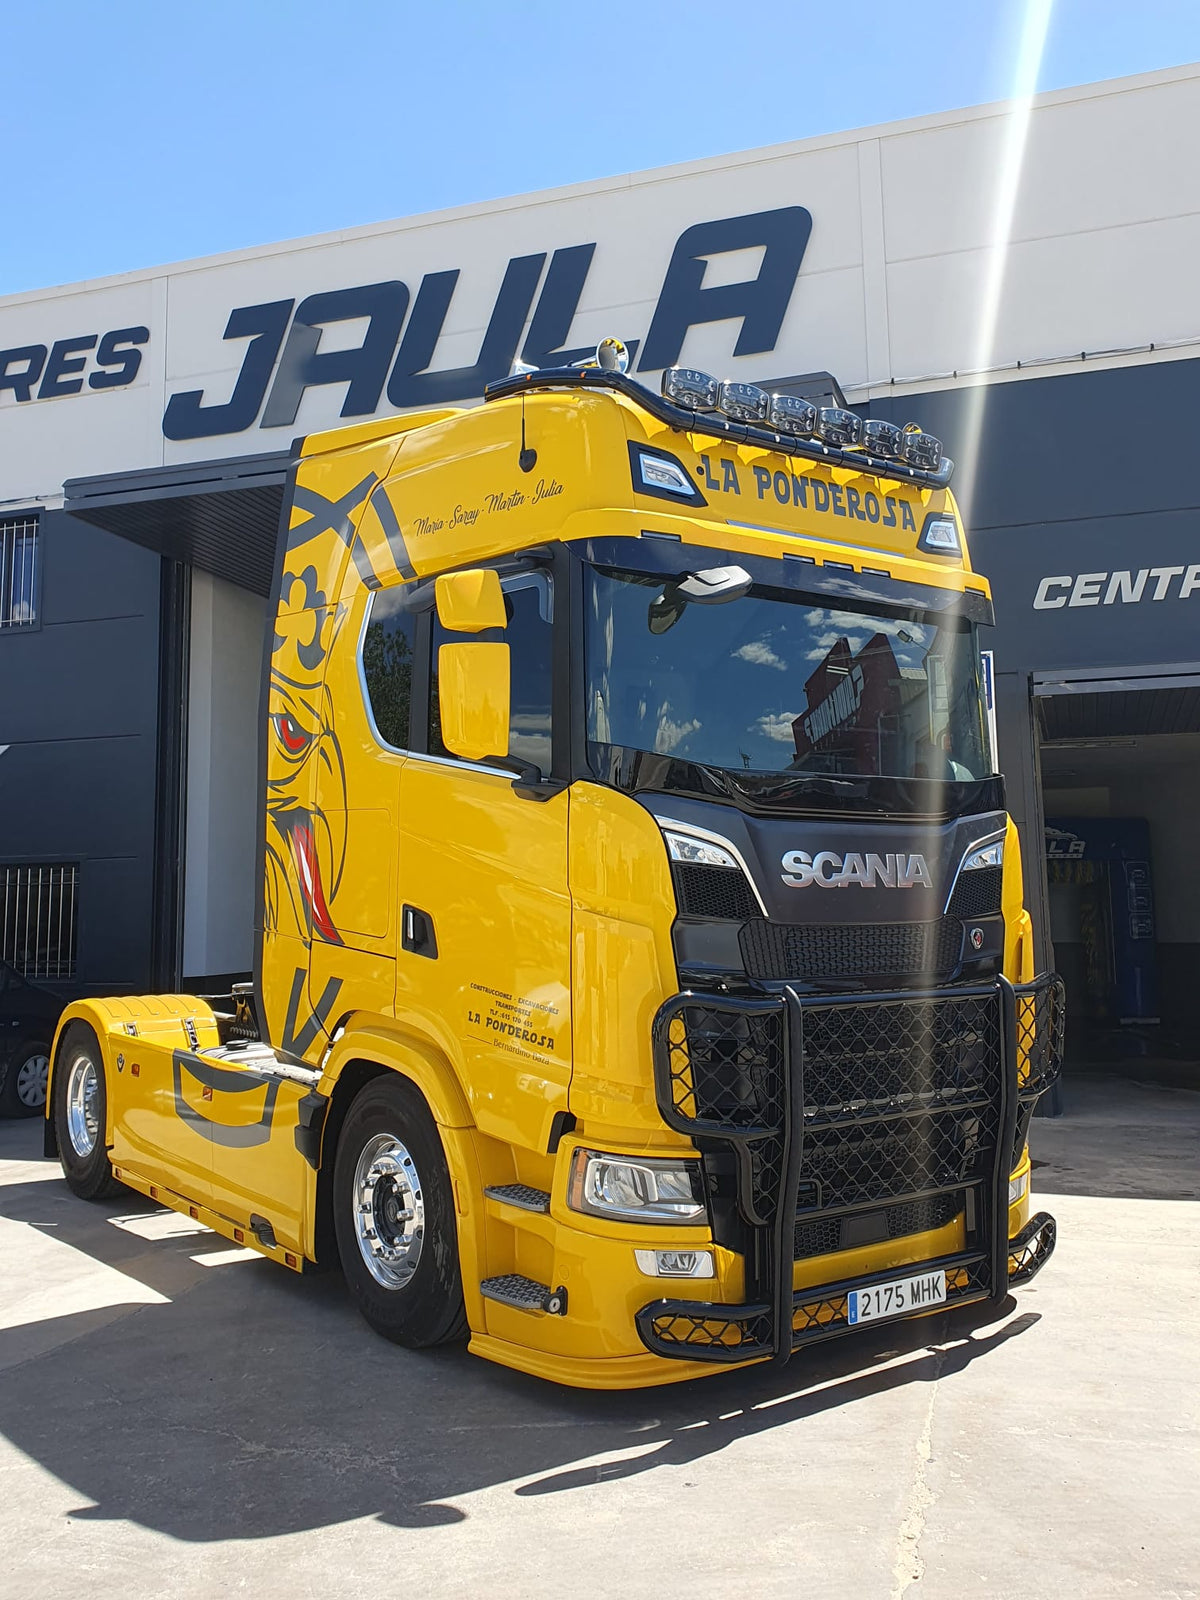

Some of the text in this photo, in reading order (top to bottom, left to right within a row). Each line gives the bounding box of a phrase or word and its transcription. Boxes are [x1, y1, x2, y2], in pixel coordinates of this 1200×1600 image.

[162, 206, 813, 441] JAULA
[531, 478, 565, 505] Julia
[701, 454, 917, 532] LA PONDEROSA
[780, 850, 933, 888] SCANIA
[470, 982, 559, 1014] CONSTRUCCIONES EXCAVACIONES
[495, 1000, 531, 1016] TRANSPORTES
[468, 1011, 554, 1049] LA PONDEROSA
[493, 1038, 531, 1058] Bernardino
[861, 1275, 942, 1317] 2175 MHK
